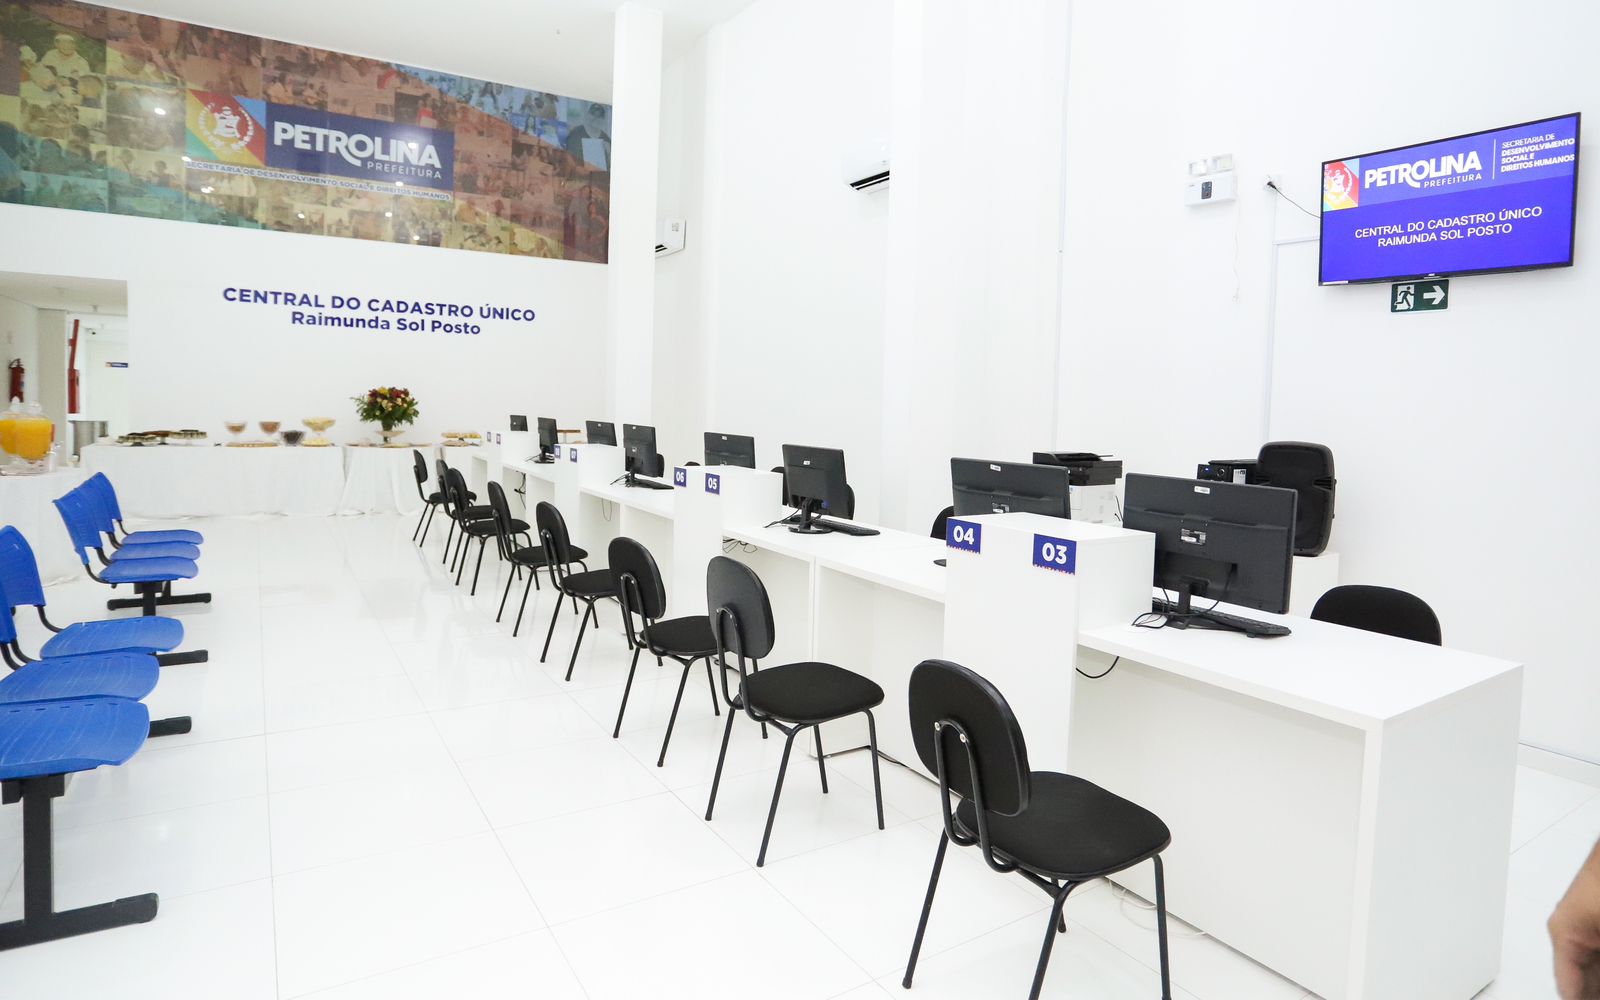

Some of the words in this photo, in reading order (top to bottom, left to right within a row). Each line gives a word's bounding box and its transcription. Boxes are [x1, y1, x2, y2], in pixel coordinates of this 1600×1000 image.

[274, 120, 442, 169] PETROLINA
[1501, 138, 1575, 157] DESENVOLVIMENTO
[1502, 135, 1544, 149] SECRETARIA
[1545, 133, 1555, 141] DE
[1501, 160, 1534, 173] DIREITOS
[1534, 153, 1575, 167] HUMANOS
[1502, 154, 1529, 164] SOCIAL
[1530, 152, 1535, 160] E
[367, 161, 442, 179] PREFEITURA
[1364, 150, 1482, 188] PETROLINA
[186, 161, 241, 174] SECRETARIA
[257, 170, 337, 186] DESENVOLVIMENTO
[340, 181, 368, 190] SOCIAL
[376, 186, 411, 196] DIREITOS
[412, 191, 450, 200] HUMANOS
[1423, 173, 1482, 188] PREFEITURA
[1355, 223, 1404, 239] CENTRAL
[1407, 221, 1425, 232] DO
[1427, 212, 1496, 230] CADASTRO
[1498, 206, 1543, 221] ÚNICO
[1377, 233, 1438, 248] RAIMUNDA
[1440, 229, 1465, 241] SOL
[1467, 223, 1513, 238] POSTO
[223, 287, 325, 308] CENTRAL
[331, 295, 361, 310] DO
[367, 298, 474, 318] CADASTRO
[479, 303, 536, 322] ÚNICO
[291, 311, 390, 330] Raimunda
[396, 317, 425, 332] Sol
[431, 320, 481, 335] Posto
[675, 471, 685, 483] 06
[707, 477, 718, 490] 05
[953, 525, 975, 545] 04
[1041, 542, 1068, 565] 03
